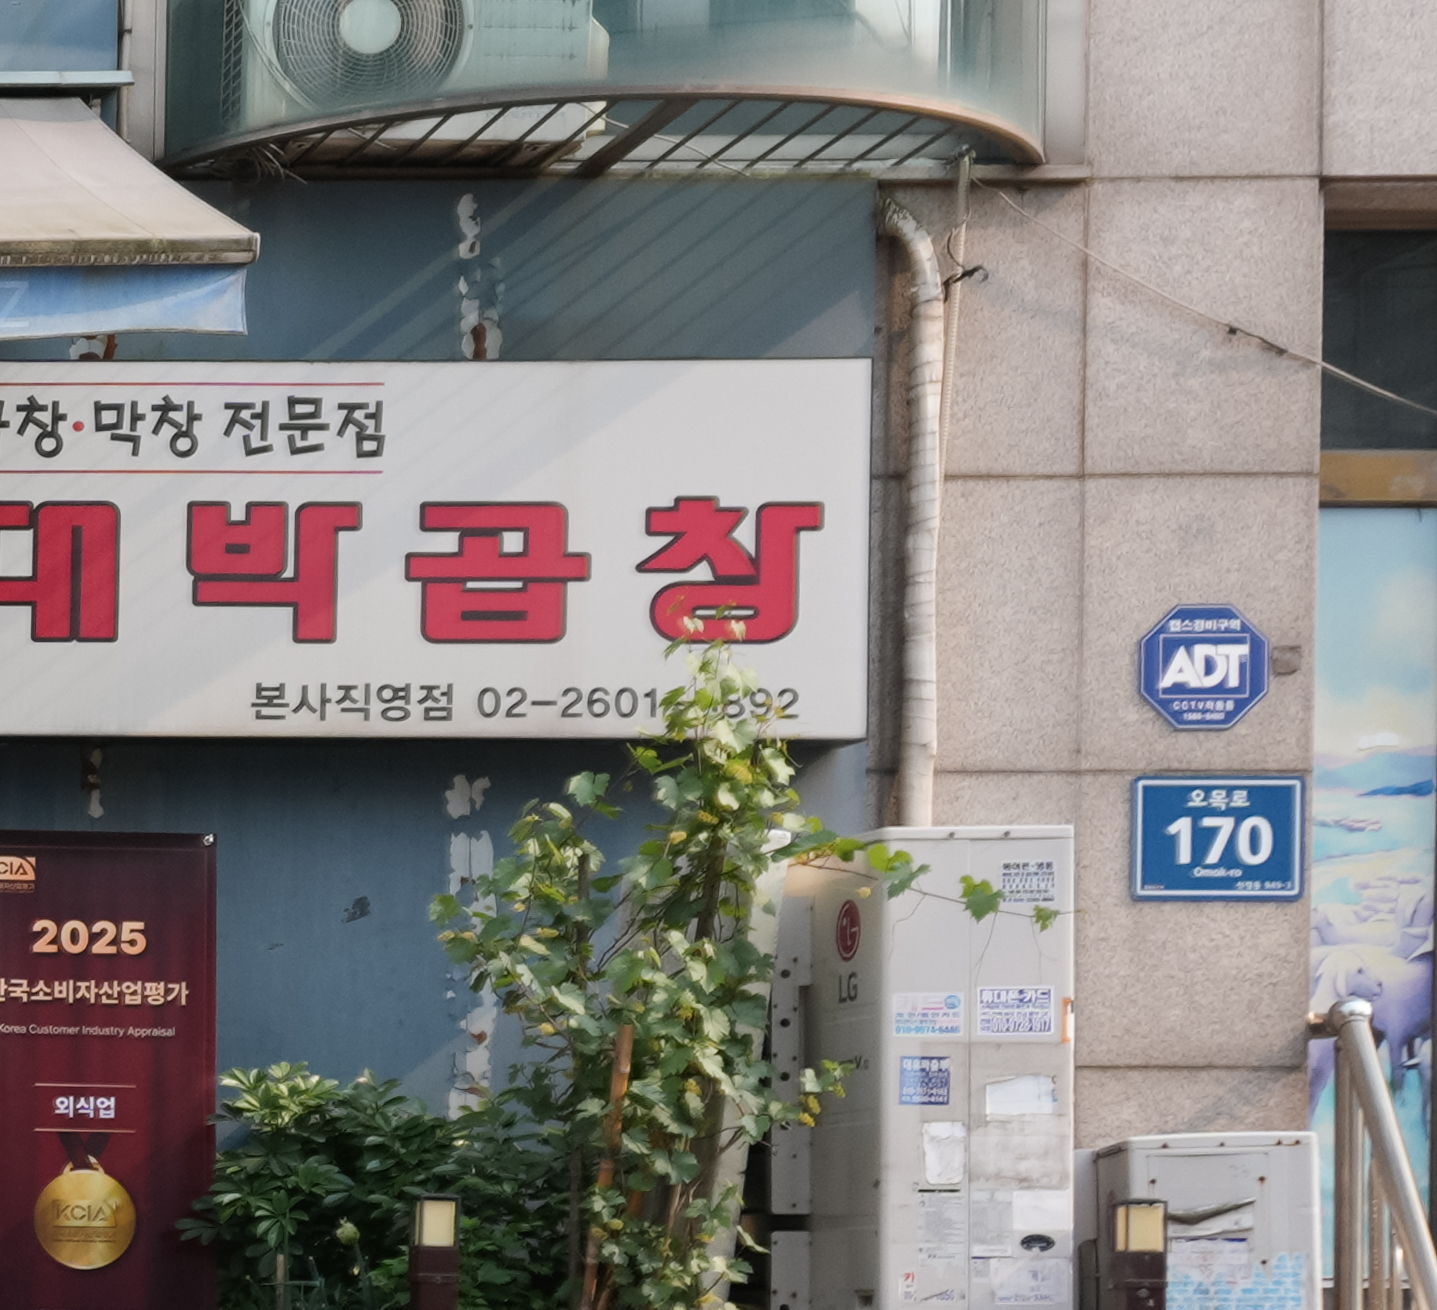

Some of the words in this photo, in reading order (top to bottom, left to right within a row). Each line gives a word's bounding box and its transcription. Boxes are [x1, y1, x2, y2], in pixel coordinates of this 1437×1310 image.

[223, 395, 385, 459] 전문점
[1160, 644, 1250, 689] ADT
[250, 681, 455, 722] 본사직영점
[476, 685, 800, 723] 02-2601892
[1187, 790, 1251, 810] 오목로
[1166, 816, 1274, 865] 170
[1193, 866, 1243, 878] Omok-ro
[31, 919, 148, 955] 2025
[838, 972, 858, 1004] LG
[29, 1023, 80, 1036] Customer
[82, 1023, 125, 1038] Industry
[127, 1025, 176, 1039] Appraisal
[54, 1095, 116, 1119] 외식업
[53, 1200, 113, 1222] KCIA
